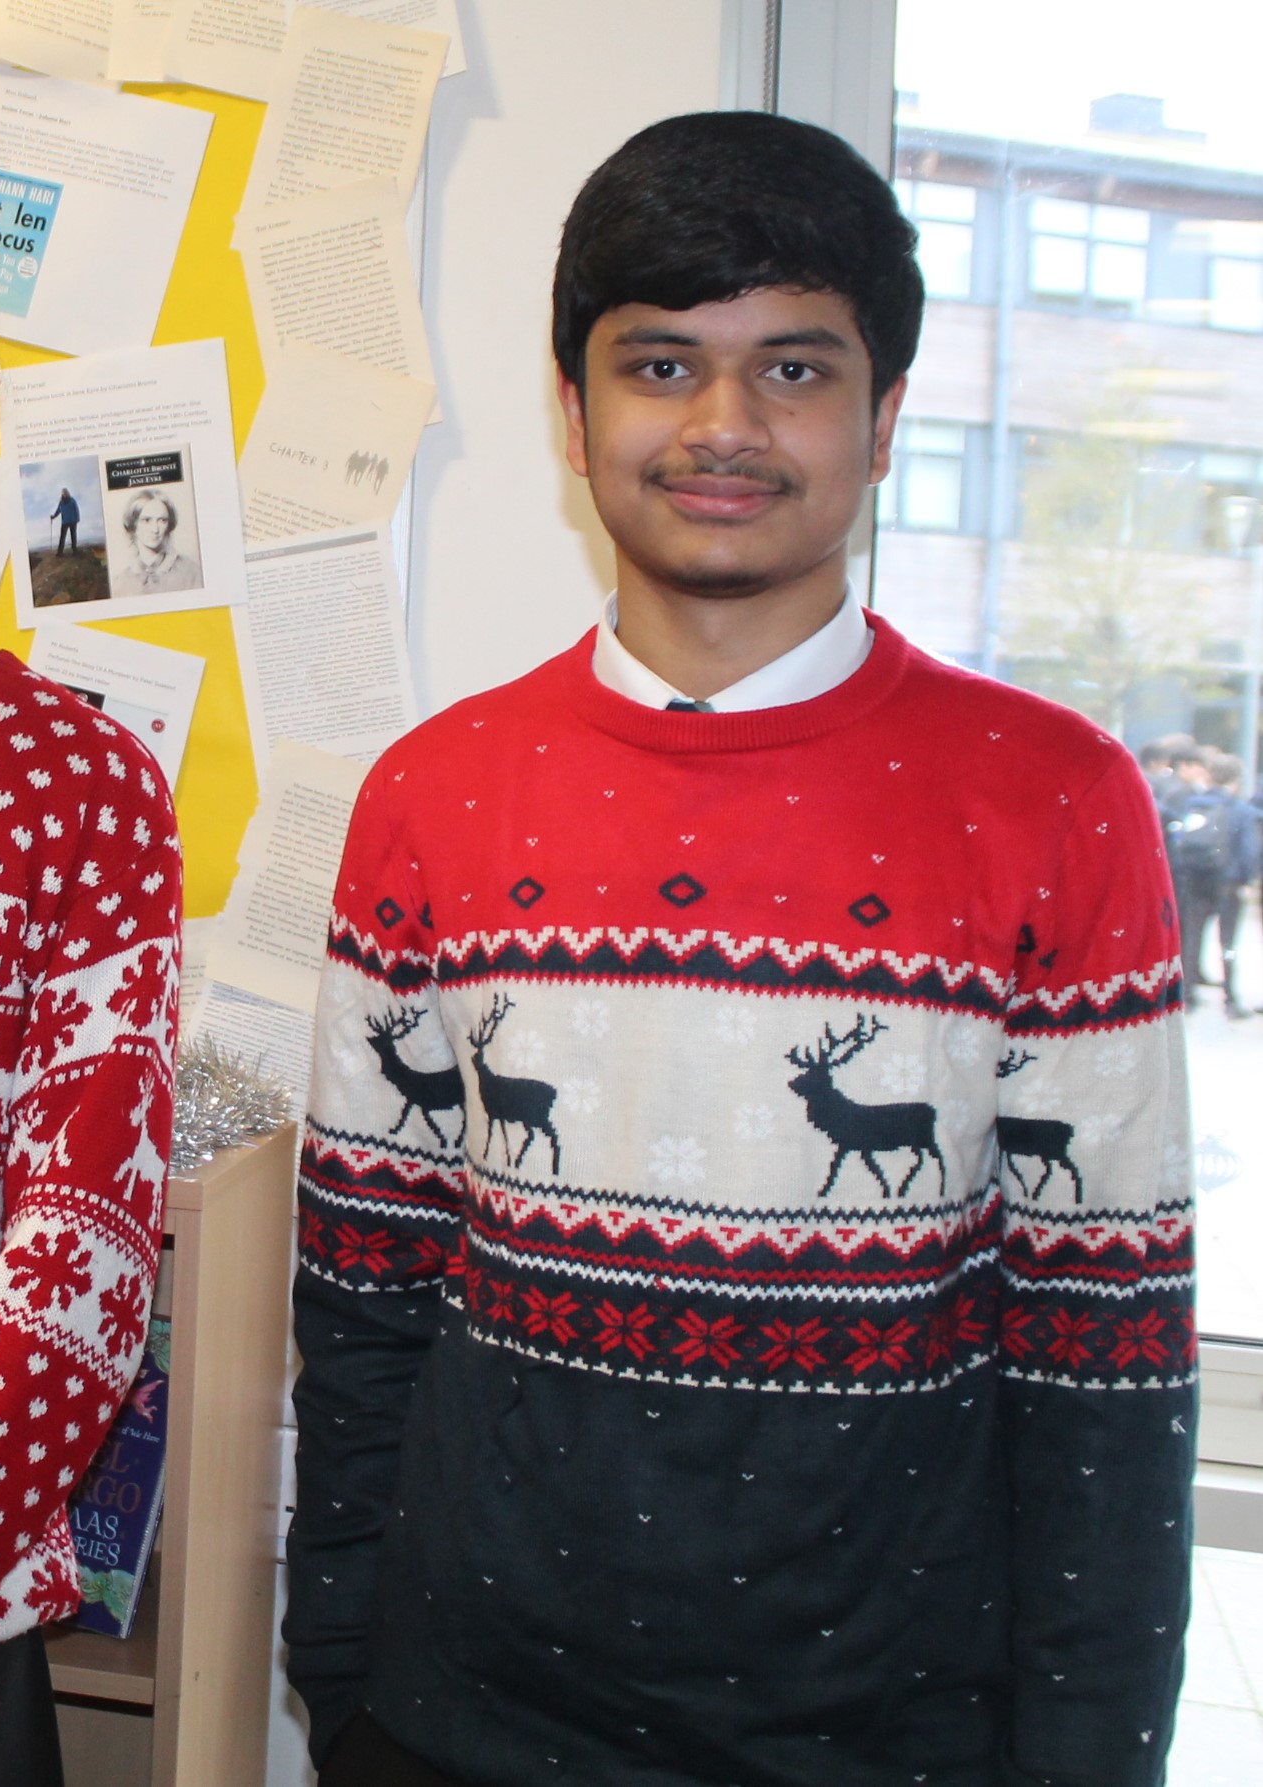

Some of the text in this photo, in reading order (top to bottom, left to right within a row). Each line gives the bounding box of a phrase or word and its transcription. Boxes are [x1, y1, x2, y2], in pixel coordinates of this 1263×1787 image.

[29, 186, 55, 206] HARI
[2, 252, 16, 266] You
[0, 268, 14, 284] Pay
[269, 442, 318, 465] CHAPTER
[111, 466, 151, 478] CHARLOTTE
[129, 475, 162, 488] JANE EYRE
[73, 1535, 121, 1567] RIES
